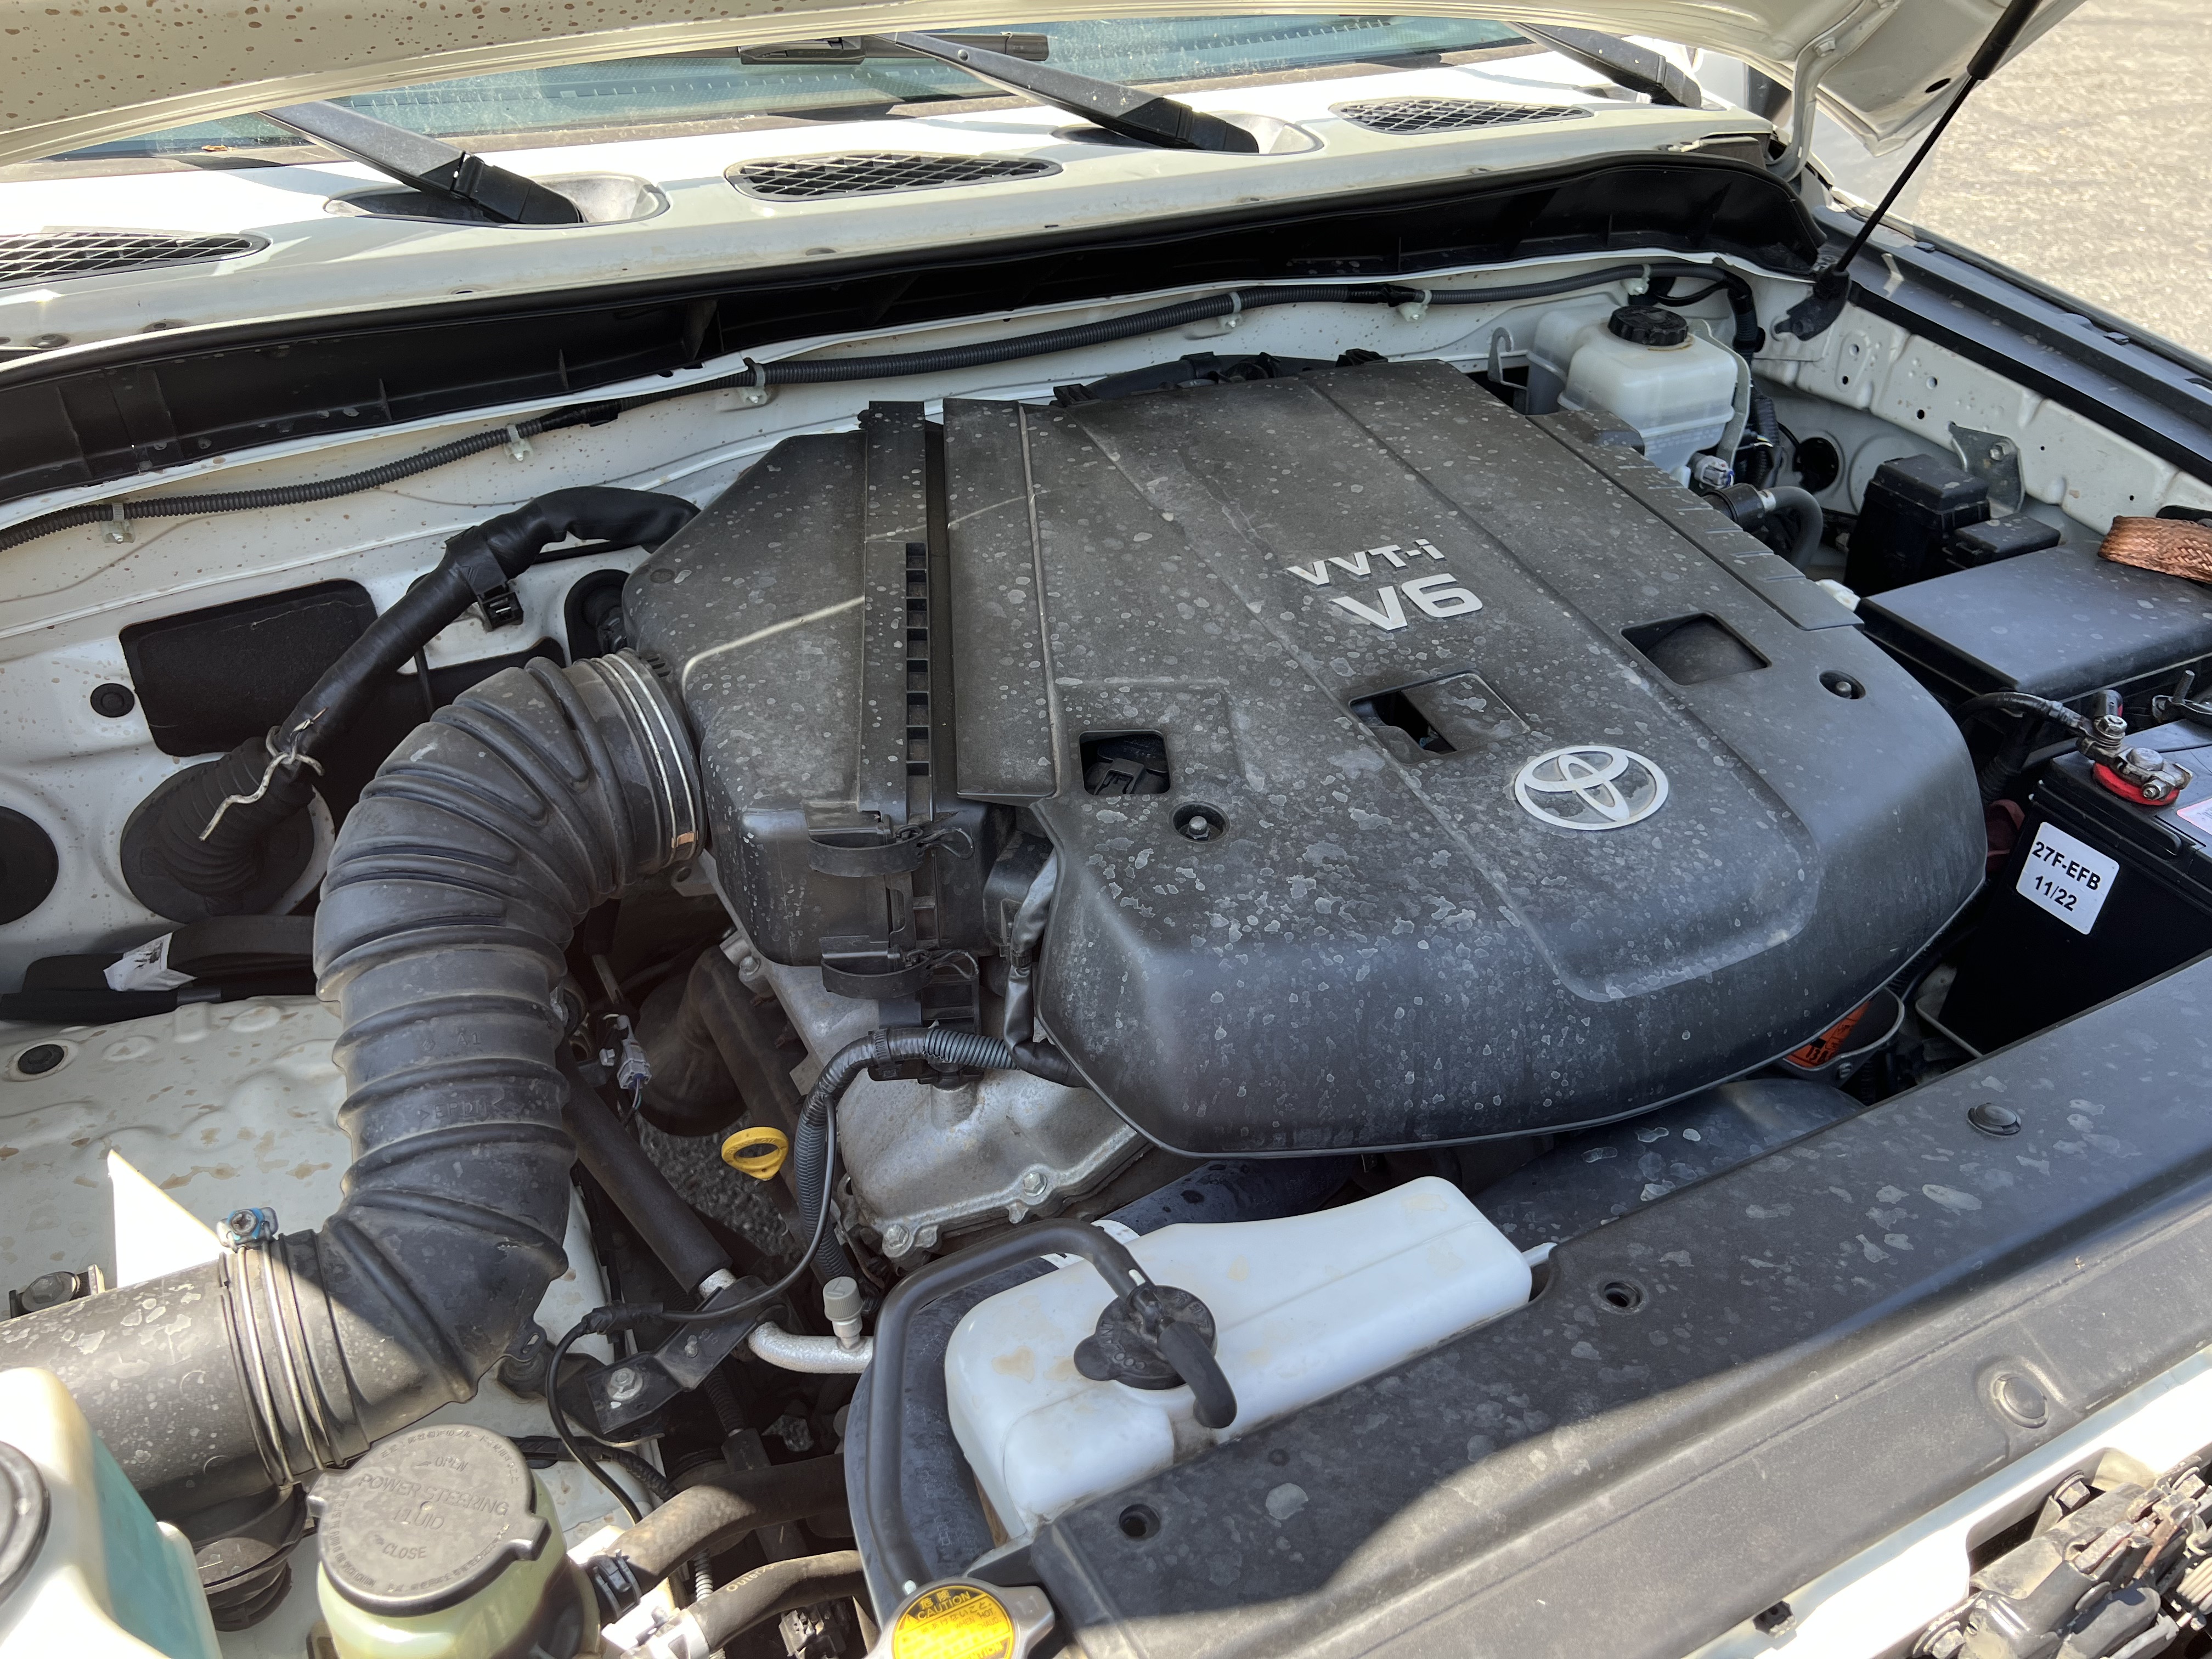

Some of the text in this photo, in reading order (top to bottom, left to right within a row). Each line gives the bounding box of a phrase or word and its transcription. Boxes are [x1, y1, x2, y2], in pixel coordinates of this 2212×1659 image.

[1286, 538, 1445, 585] VVT-i
[1330, 573, 1483, 630] V6
[2032, 841, 2101, 890] 27F-EFB
[2035, 876, 2077, 912] 11/22
[434, 1455, 469, 1472] OPEN
[358, 1473, 510, 1517] POWER STEERING
[391, 1506, 445, 1530] FLUID
[382, 1543, 427, 1560] CLOSE
[917, 1590, 972, 1621] CAUTION
[954, 1616, 975, 1630] WHEN
